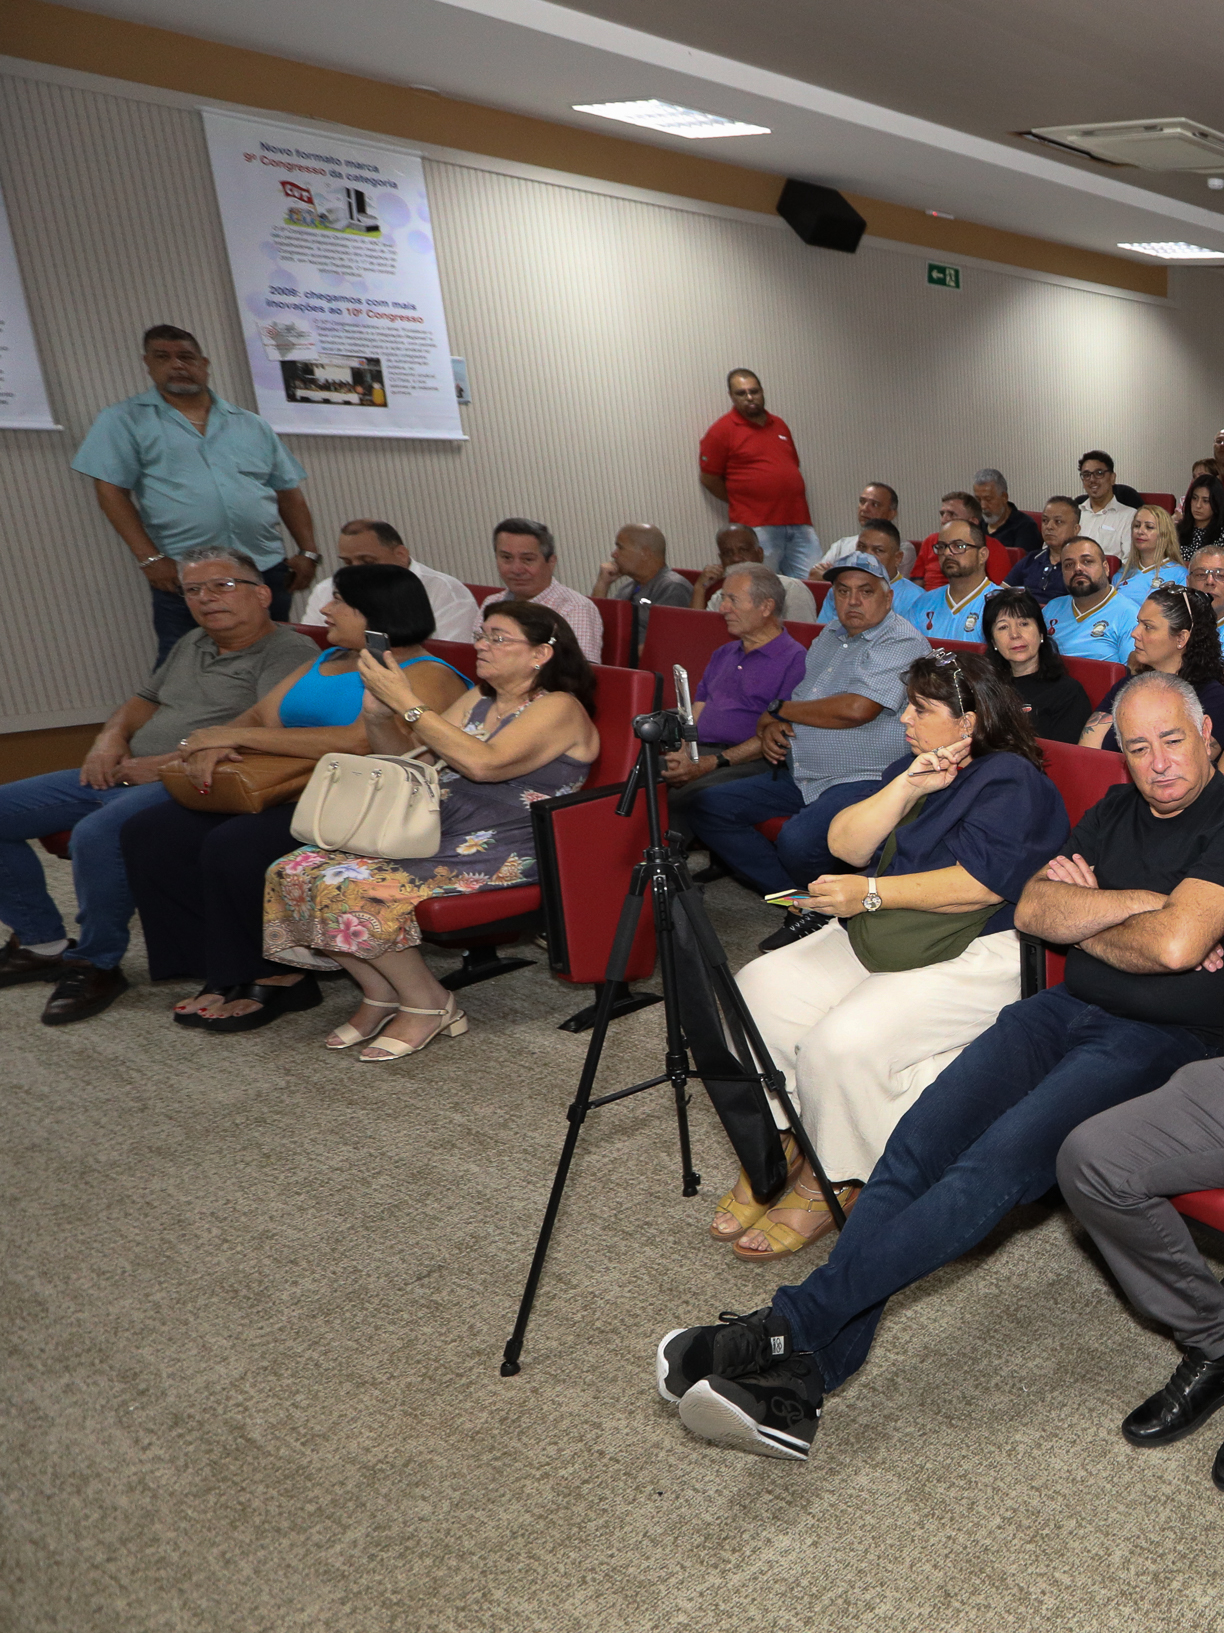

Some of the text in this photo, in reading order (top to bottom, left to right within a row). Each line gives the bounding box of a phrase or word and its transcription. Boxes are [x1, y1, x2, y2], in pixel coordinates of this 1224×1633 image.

[259, 141, 380, 174] Novo formato marca
[259, 154, 327, 176] Congresso
[328, 168, 344, 180] da
[346, 172, 399, 189] categoria
[285, 184, 310, 200] CUT
[265, 298, 326, 314] inovações
[328, 306, 343, 315] ao
[365, 309, 424, 324] Congresso
[304, 290, 363, 306] chegamos
[366, 298, 390, 308] com
[391, 301, 417, 311] mais
